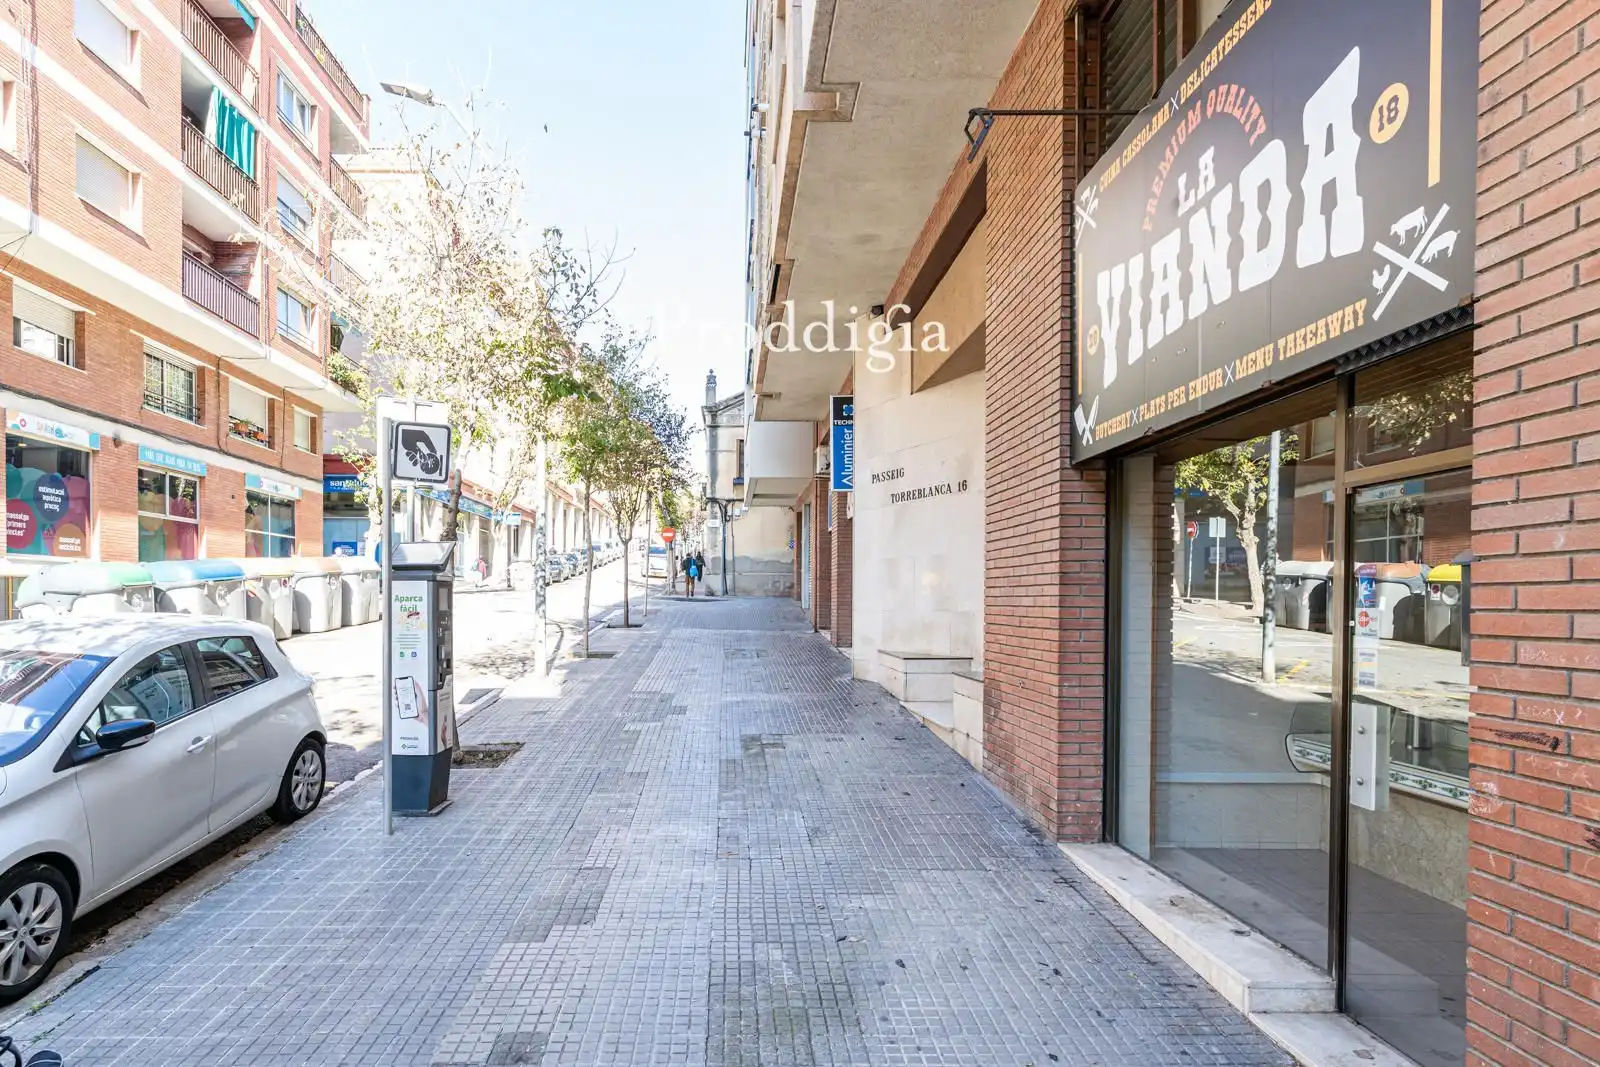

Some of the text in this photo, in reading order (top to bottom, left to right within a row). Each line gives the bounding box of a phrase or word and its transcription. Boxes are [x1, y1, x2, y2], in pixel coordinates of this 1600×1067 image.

[1377, 94, 1400, 133] 18
[1141, 84, 1267, 232] PREMIUM QUALITY
[1178, 145, 1215, 218] LA
[1097, 45, 1364, 390] VIANDA
[1095, 298, 1368, 441] BUTCHERY PLATS PER ENDUR MENU TAKEAWAY
[841, 428, 853, 487] Aluminier
[871, 467, 905, 485] PASSEIG
[890, 479, 969, 504] TORREBLANCA 16
[394, 595, 423, 604] Aparca
